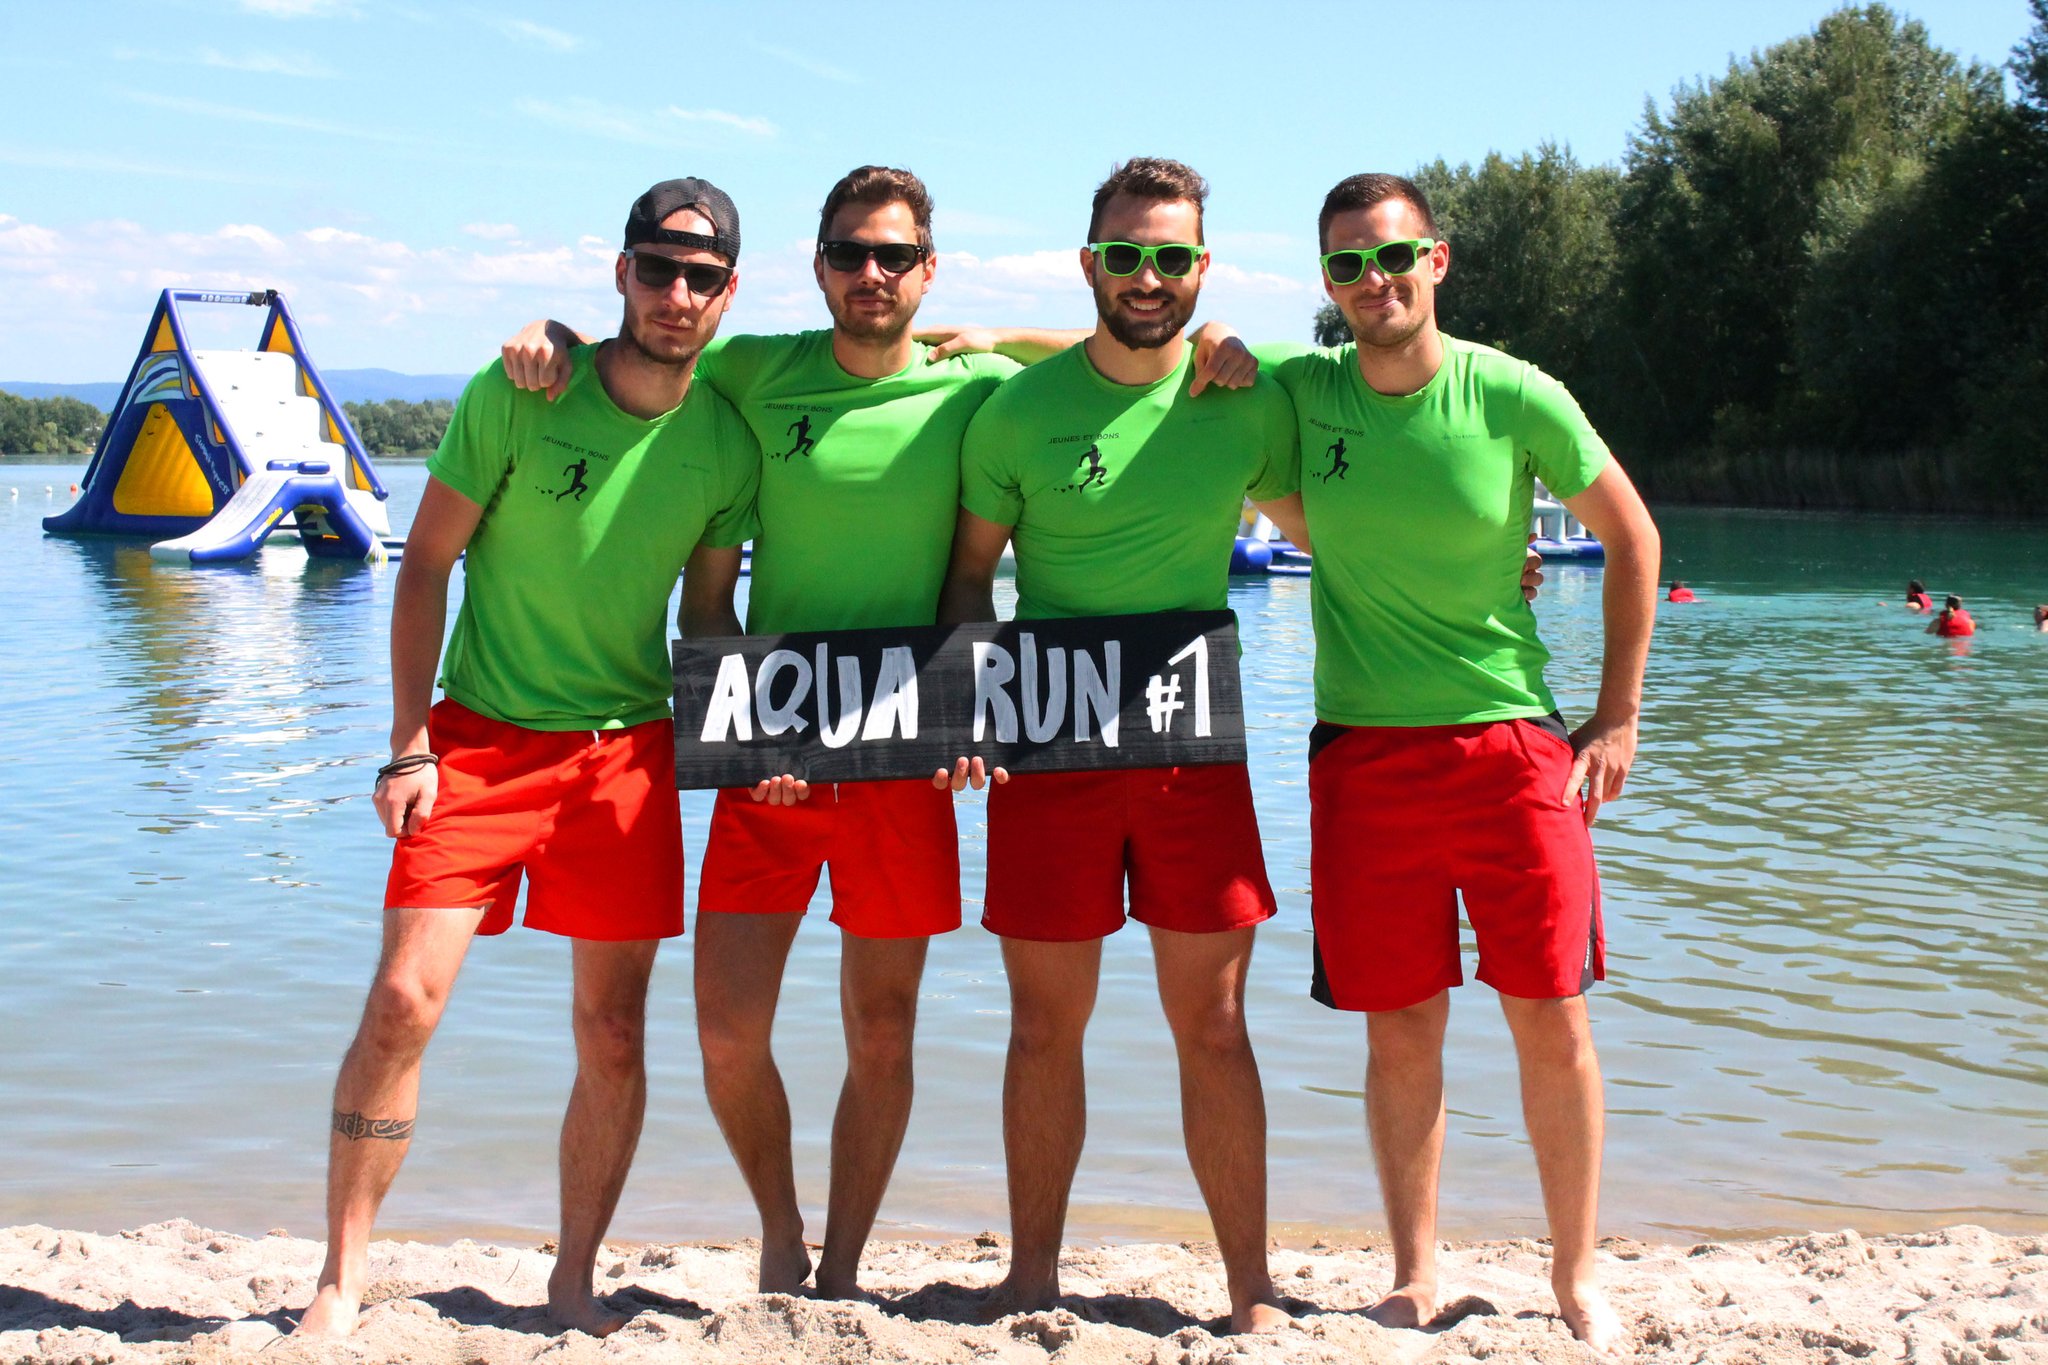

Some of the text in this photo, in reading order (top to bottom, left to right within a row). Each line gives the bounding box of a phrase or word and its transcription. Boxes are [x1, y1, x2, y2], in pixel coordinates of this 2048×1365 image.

[762, 402, 795, 411] JEUNES
[810, 405, 833, 413] BONS
[1307, 418, 1332, 431] JEUNES
[1047, 435, 1080, 445] JEUNES
[1097, 432, 1120, 440] BONS
[542, 434, 610, 461] JEUNES ET BONS
[700, 632, 1211, 748] AQUA RUN #1
